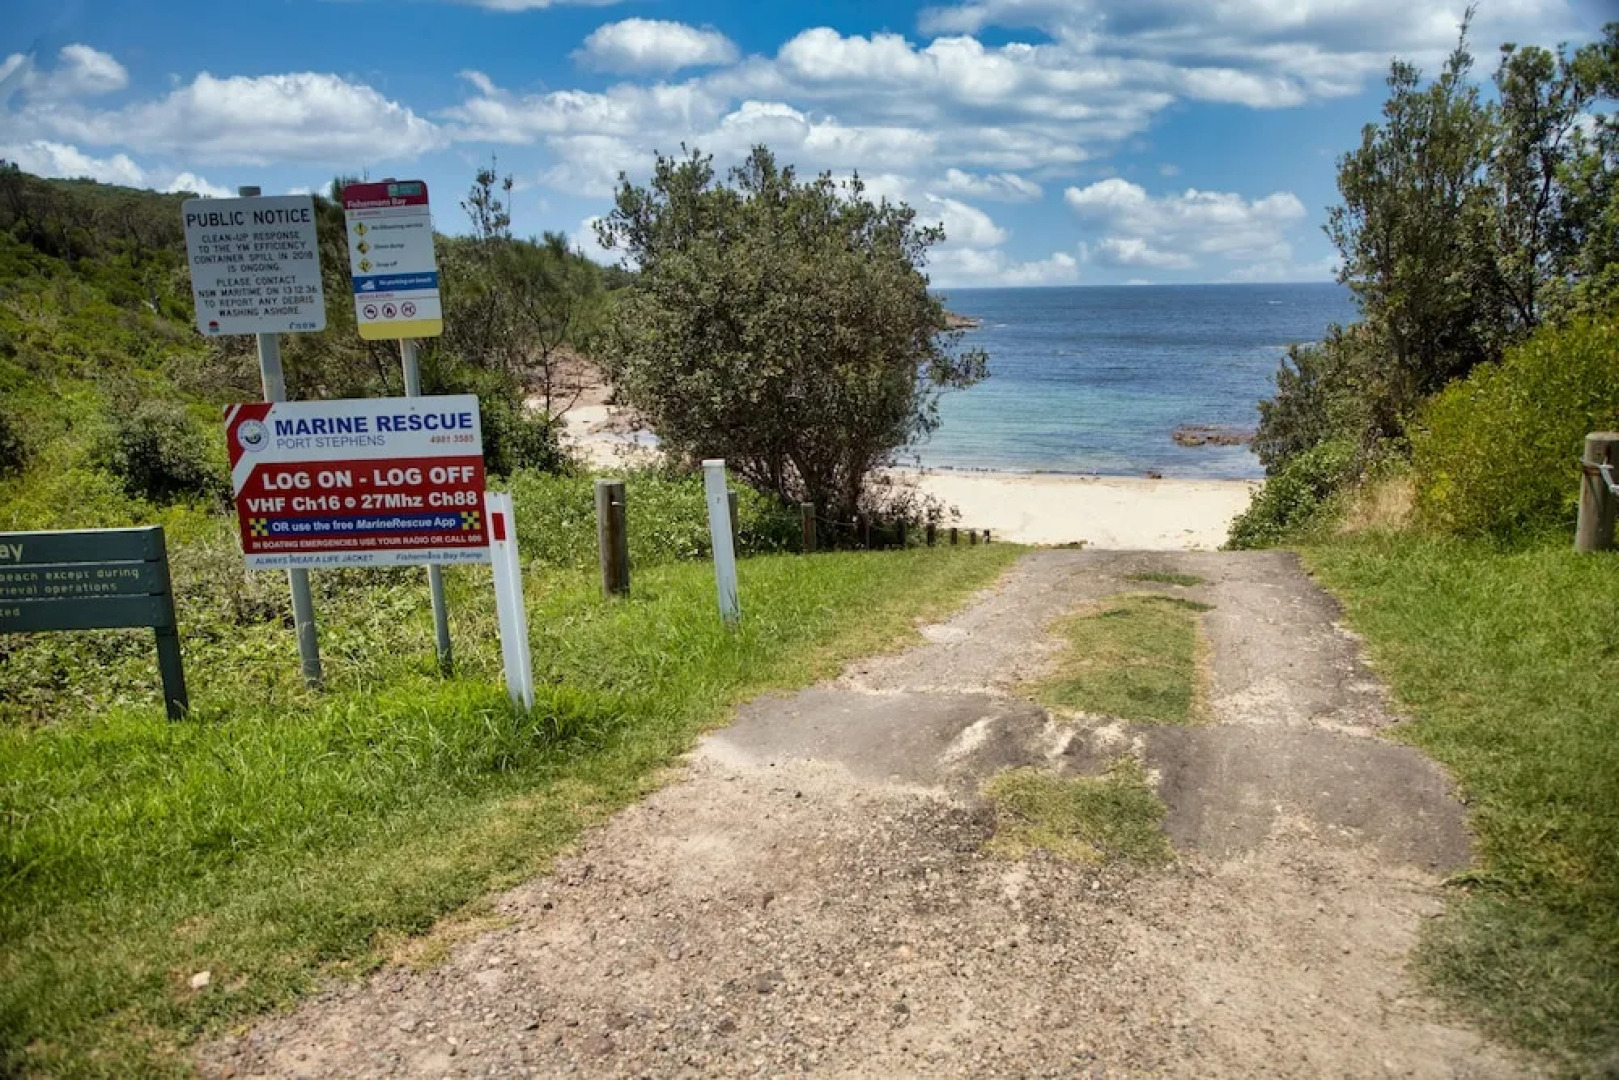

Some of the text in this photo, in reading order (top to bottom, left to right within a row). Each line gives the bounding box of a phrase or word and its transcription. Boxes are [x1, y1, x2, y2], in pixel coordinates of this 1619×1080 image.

[186, 209, 310, 228] PUBLIC NOTICE
[202, 231, 300, 243] CLEAN-UP RESPONSE
[254, 241, 306, 250] EFFICIENCY
[194, 255, 243, 264] CONTAINER
[250, 254, 274, 262] SPILL
[293, 251, 313, 259] 2018
[217, 276, 296, 287] PLEASE CONTACT
[222, 287, 262, 296] MARITIME
[220, 298, 253, 306] REPORT
[283, 296, 314, 304] DEBRIS
[219, 308, 259, 317] WASHING
[275, 416, 368, 436] MARINE
[376, 412, 473, 432] RESCUE
[276, 435, 385, 449] PORT STEPHENS
[262, 472, 311, 490] LOG
[318, 470, 353, 488] ON
[373, 468, 422, 487] LOG
[429, 466, 475, 484] OFF
[246, 491, 477, 513] VHF Ch16 27Mhz Ch88
[272, 516, 456, 532] OR use the free MarineRescue App
[253, 541, 261, 549] IN
[262, 540, 298, 549] BOATING
[299, 538, 358, 548] EMERGENCIES
[359, 538, 376, 546] USE
[378, 537, 401, 546] YOUR
[403, 536, 428, 545] RADIO
[430, 536, 443, 544] OR
[445, 535, 466, 543] CALL
[255, 557, 288, 565] ALWAYS
[289, 555, 313, 564] WEAR
[341, 554, 373, 563] JACKET
[442, 553, 458, 561] Bay
[44, 582, 117, 594] operations
